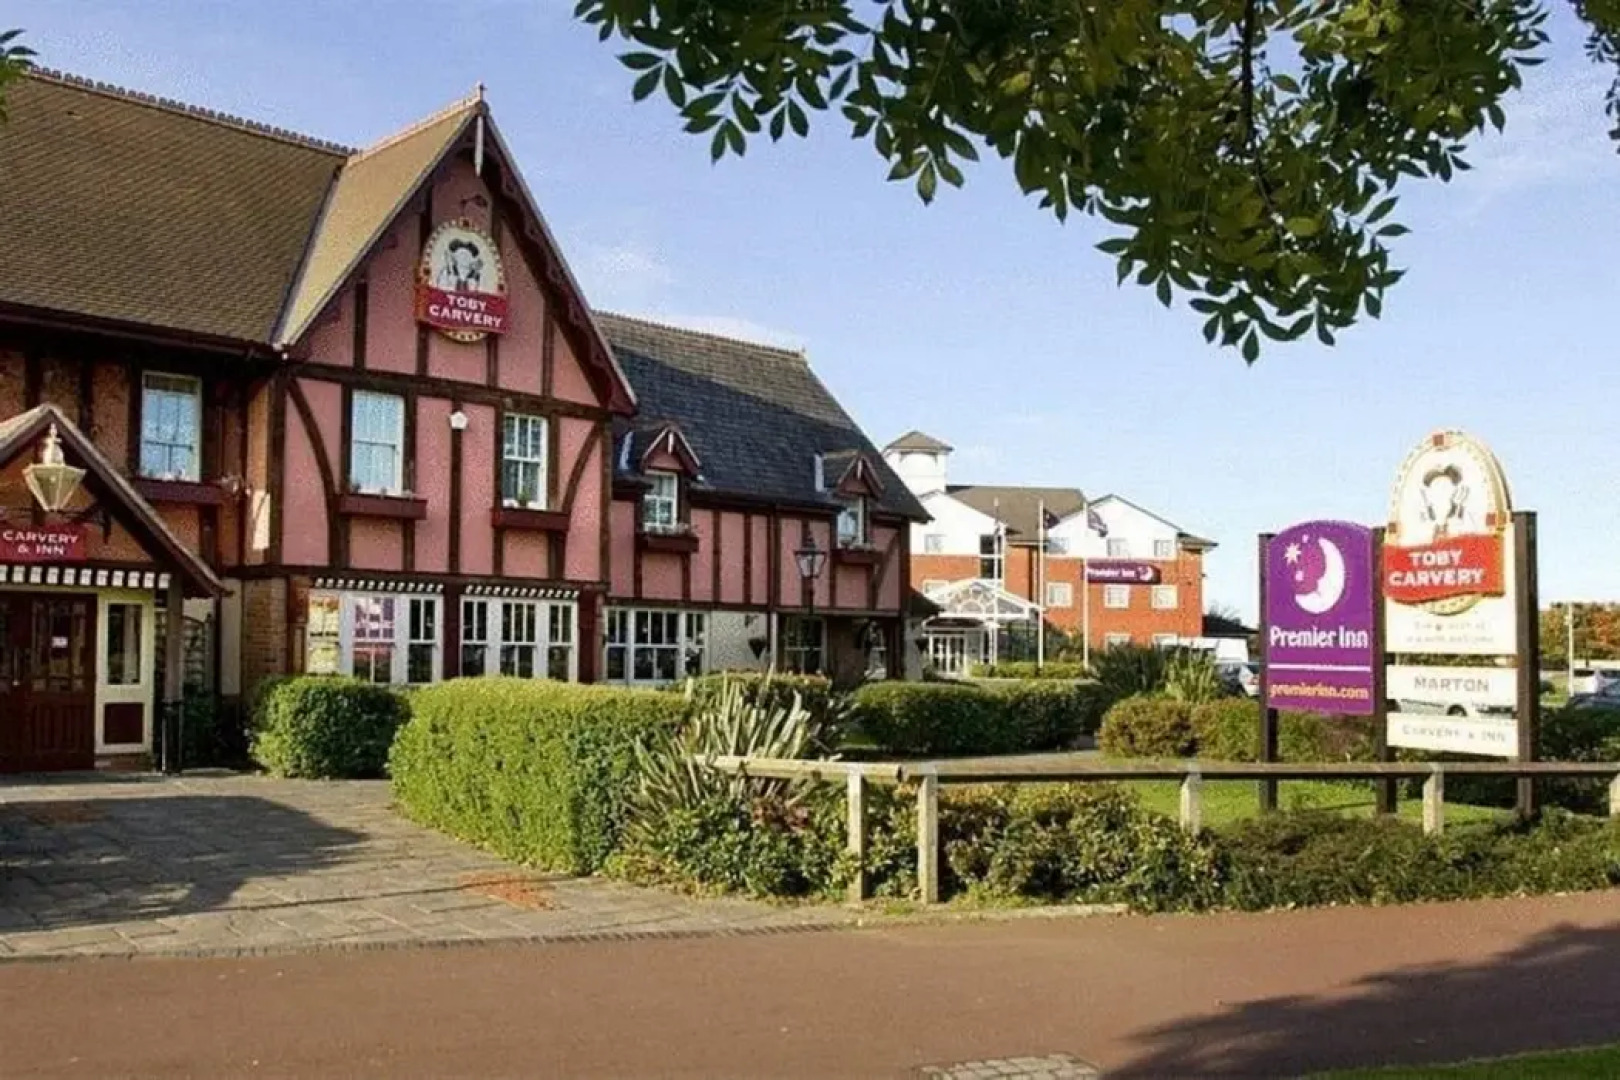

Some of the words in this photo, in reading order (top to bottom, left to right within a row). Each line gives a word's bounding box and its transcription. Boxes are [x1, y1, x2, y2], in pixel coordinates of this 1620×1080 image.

[446, 294, 487, 312] TOBY
[428, 304, 503, 328] CARVERY
[2, 529, 78, 544] CARVERY
[17, 543, 29, 554] &
[36, 544, 64, 556] INN
[1408, 548, 1462, 567] TOBY
[1389, 567, 1485, 587] CARVERY
[1270, 625, 1336, 649] Premier
[1338, 625, 1369, 649] Inn
[1269, 682, 1370, 700] premierinn.com
[1414, 677, 1490, 692] MARTON
